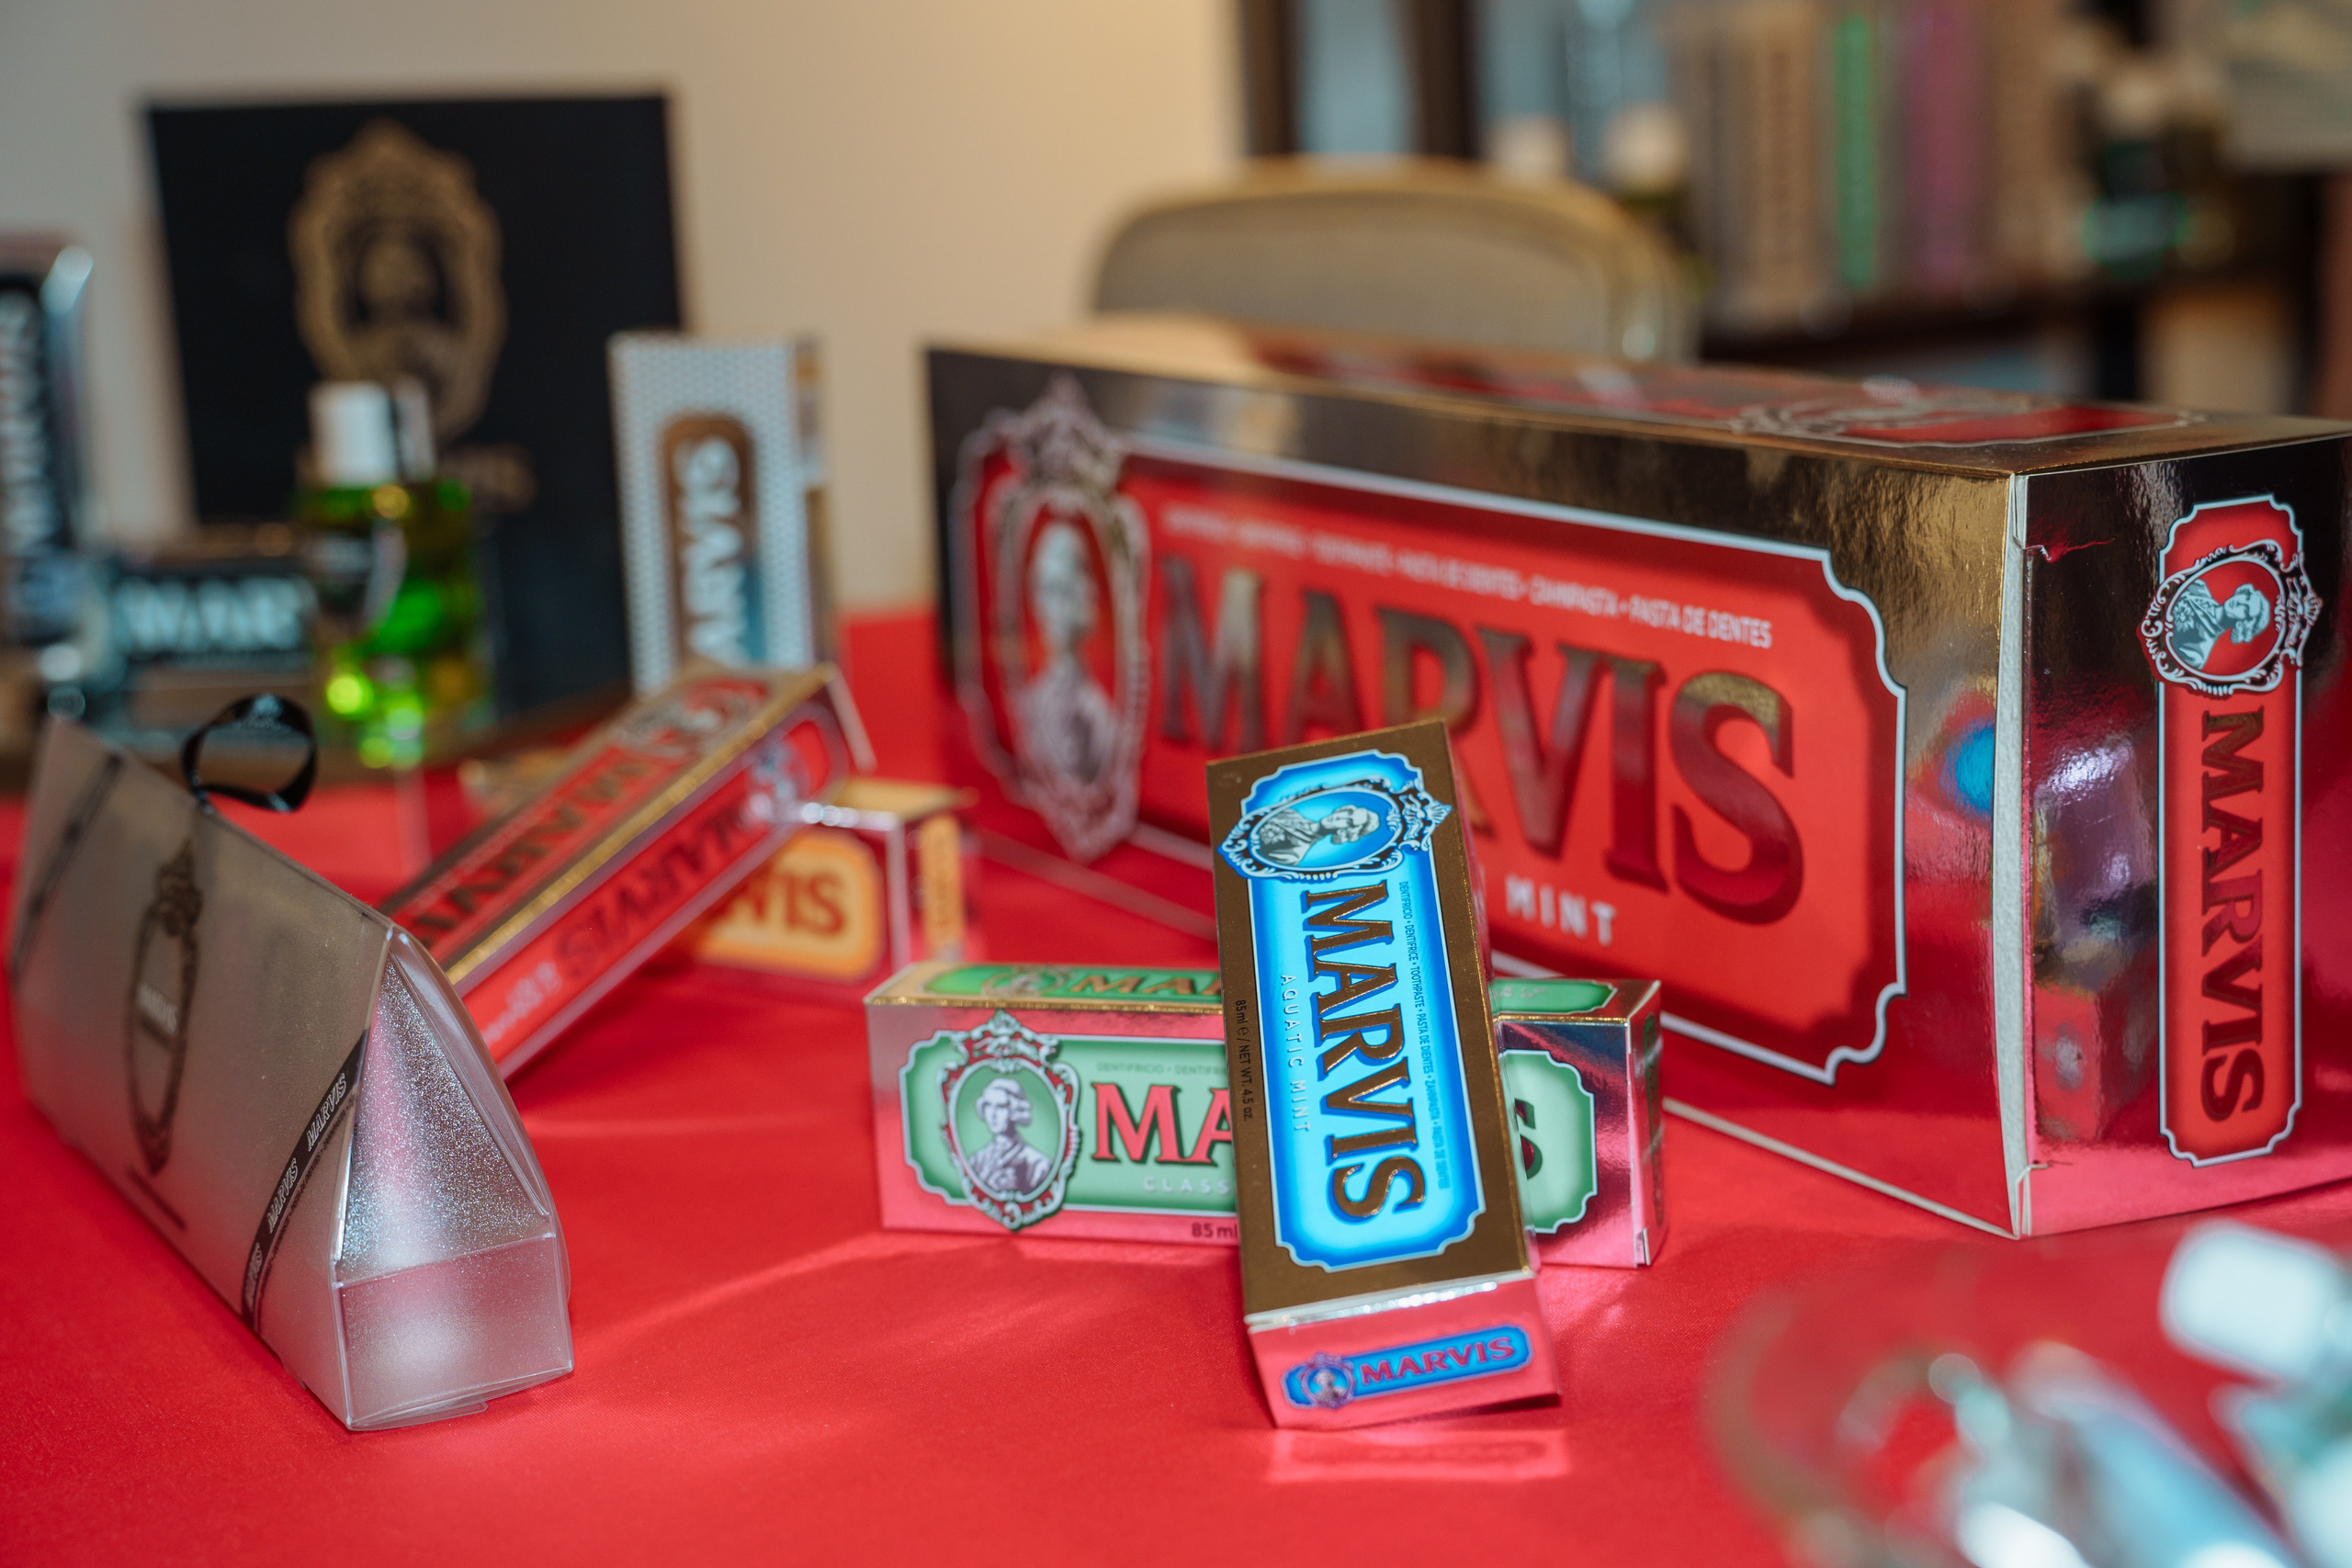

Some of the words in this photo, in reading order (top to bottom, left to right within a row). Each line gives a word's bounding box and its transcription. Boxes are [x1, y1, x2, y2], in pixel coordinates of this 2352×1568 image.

[1681, 604, 1707, 637] DE
[1708, 609, 1773, 649] DENTES
[1159, 558, 1805, 926] MARVIS
[1398, 881, 1412, 919] DENTIFRICIO
[1504, 873, 1619, 947] MINT
[2199, 705, 2266, 1123] MARVIS
[1404, 924, 1418, 961] DENTIFRICE
[1410, 965, 1424, 1008] TOOTHPASTE
[1281, 974, 1305, 1067] AQUATIC
[1416, 1012, 1428, 1034] PASTA
[1238, 1044, 1250, 1065] NET
[1300, 879, 1427, 1224] MARVIS
[1420, 1045, 1432, 1074] DIENTES
[1240, 1066, 1251, 1087] WT.
[1241, 1088, 1253, 1104] 4.5
[306, 1073, 346, 1151] MARVIS
[1290, 1079, 1310, 1134] MINT
[267, 1157, 299, 1233] MARVIS
[1361, 1337, 1516, 1385] MARVIS
